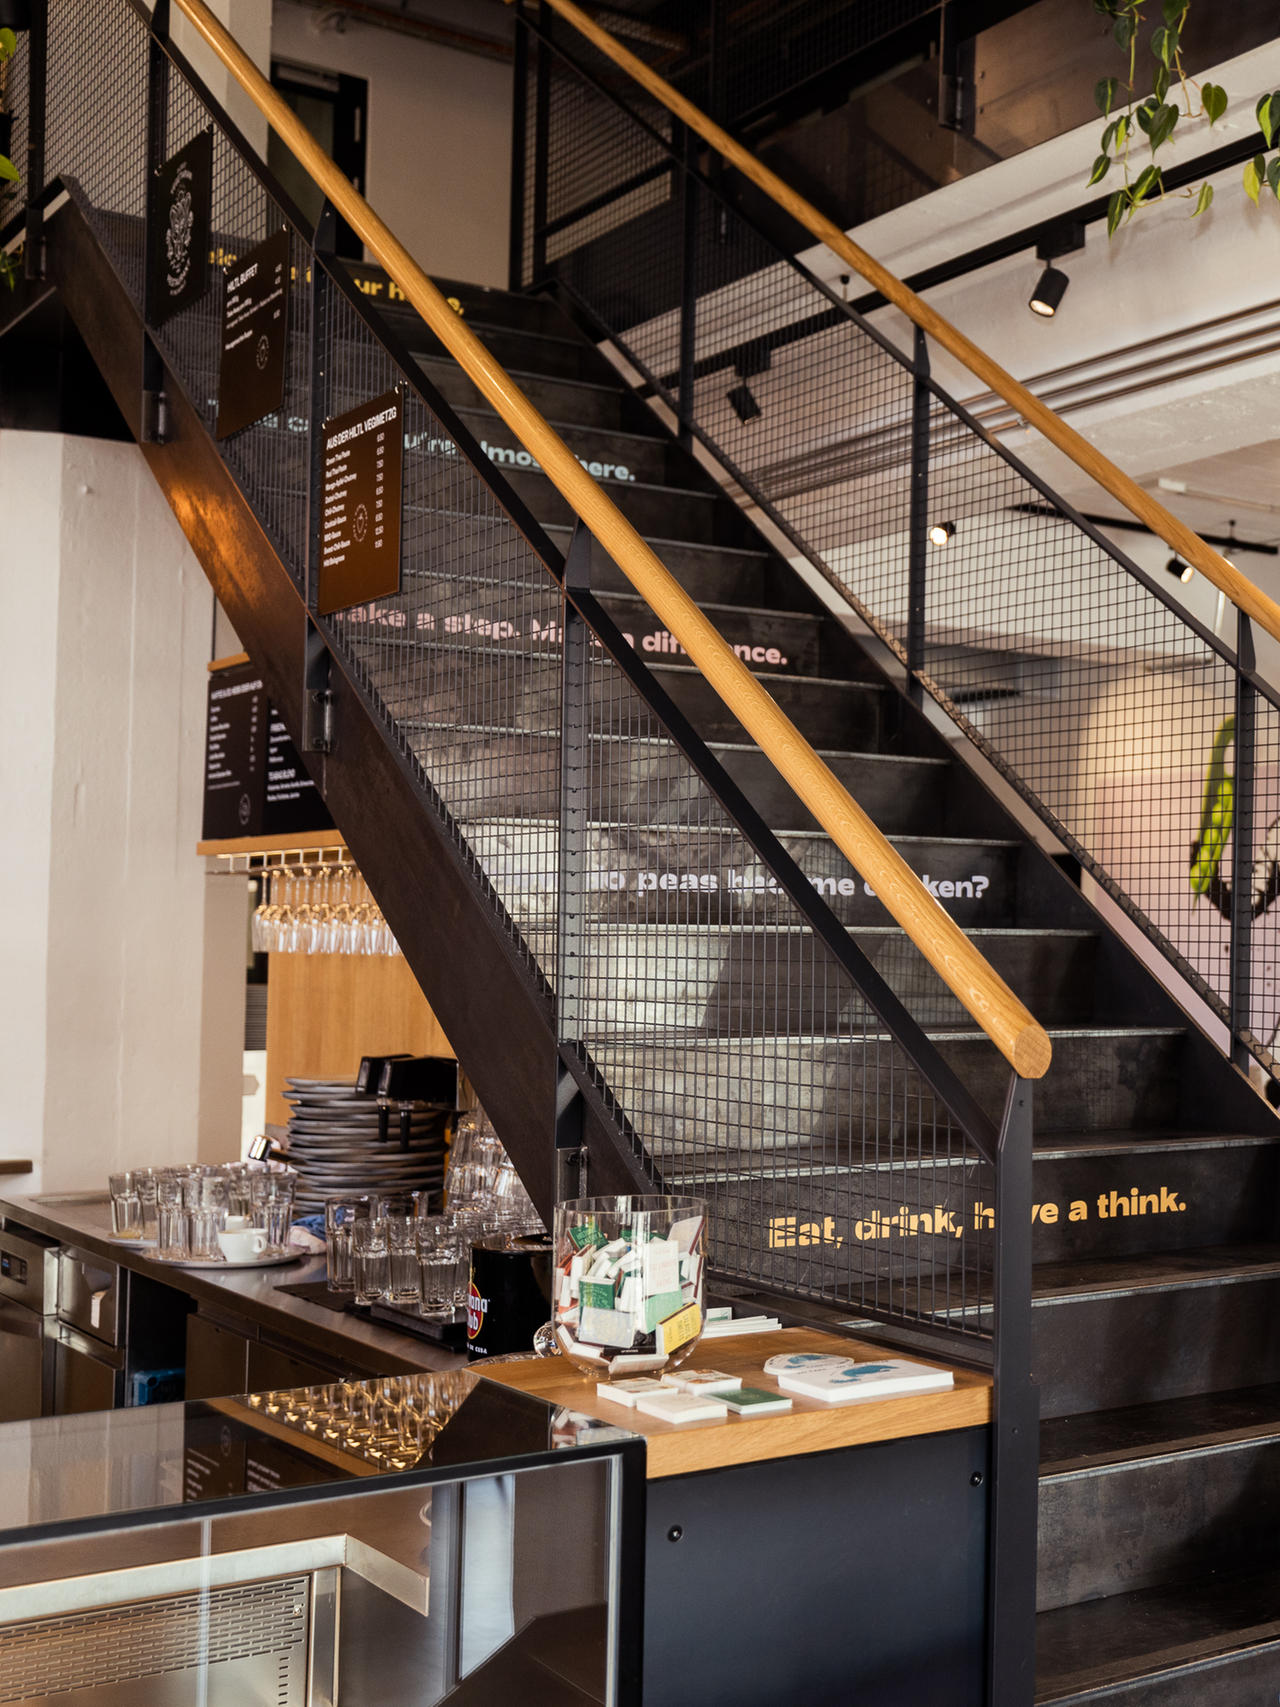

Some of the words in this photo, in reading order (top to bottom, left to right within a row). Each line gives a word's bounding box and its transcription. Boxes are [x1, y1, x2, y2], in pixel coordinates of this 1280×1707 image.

[326, 435, 337, 450] AUS
[338, 429, 349, 445] DER
[335, 602, 407, 628] ake
[416, 612, 436, 632] a
[638, 871, 718, 897] peas
[768, 1216, 844, 1250] Eat,
[854, 1205, 964, 1241] drink,
[1067, 1199, 1089, 1222] a
[1096, 1186, 1187, 1219] think.
